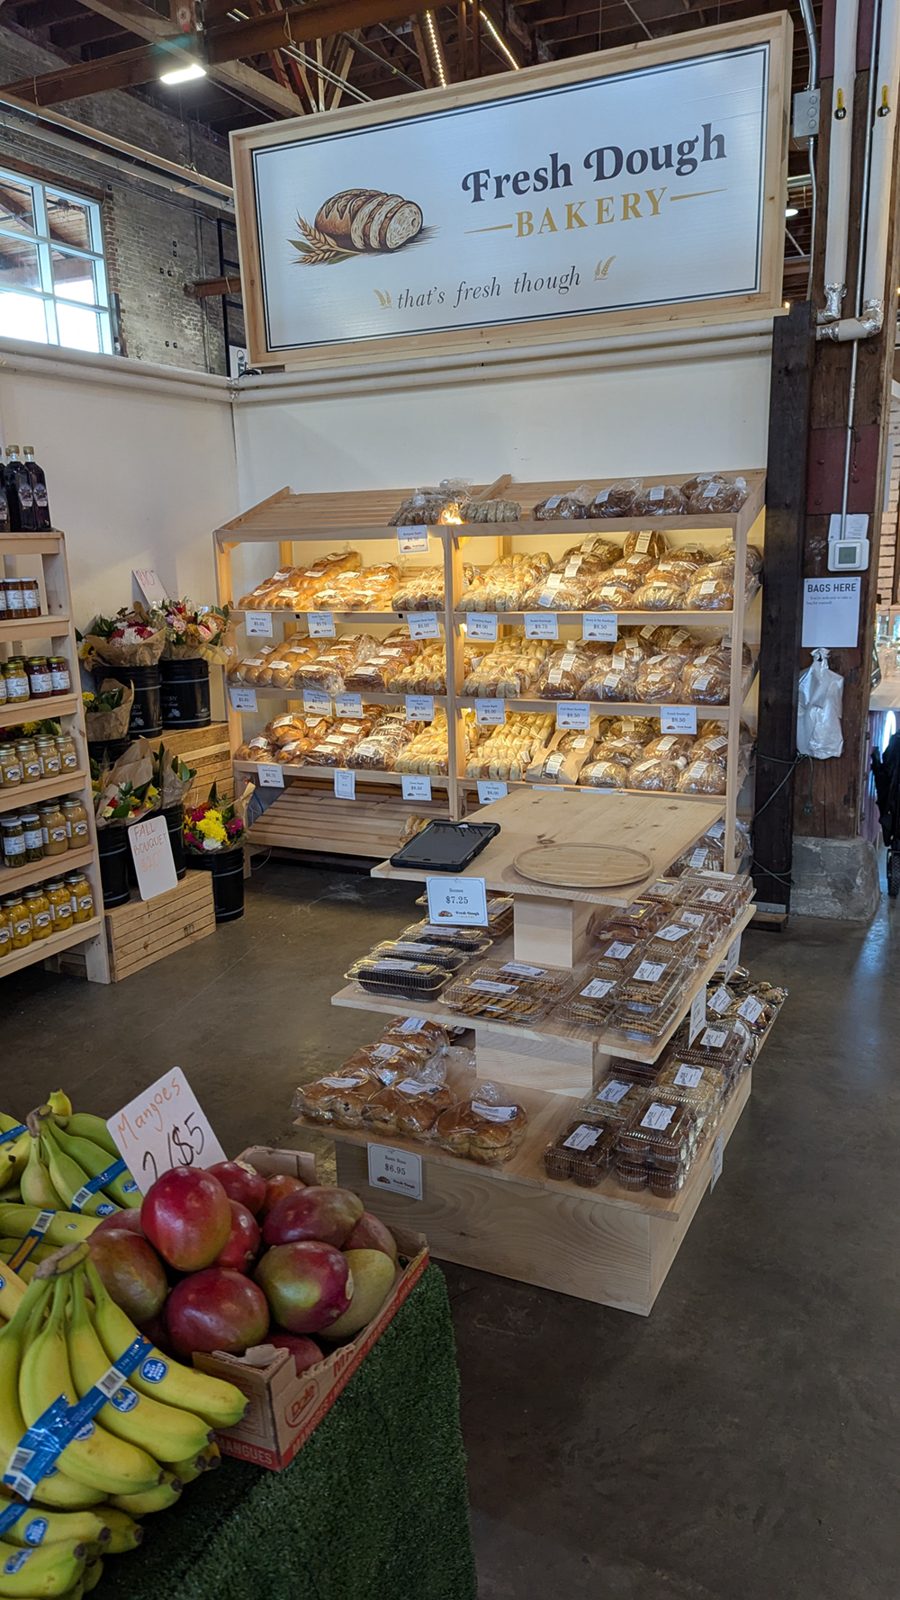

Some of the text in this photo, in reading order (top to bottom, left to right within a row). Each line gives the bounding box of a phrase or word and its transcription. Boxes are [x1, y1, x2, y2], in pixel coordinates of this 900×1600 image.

[461, 122, 728, 204] Fresh Dough
[515, 186, 670, 239] BAKERY
[397, 265, 582, 310] that's fresh though
[807, 583, 856, 592] BAGS HERE
[134, 823, 154, 840] FALL
[445, 895, 469, 905] $7.25
[117, 1077, 181, 1149] Mangoes
[384, 1163, 406, 1176] $6.95
